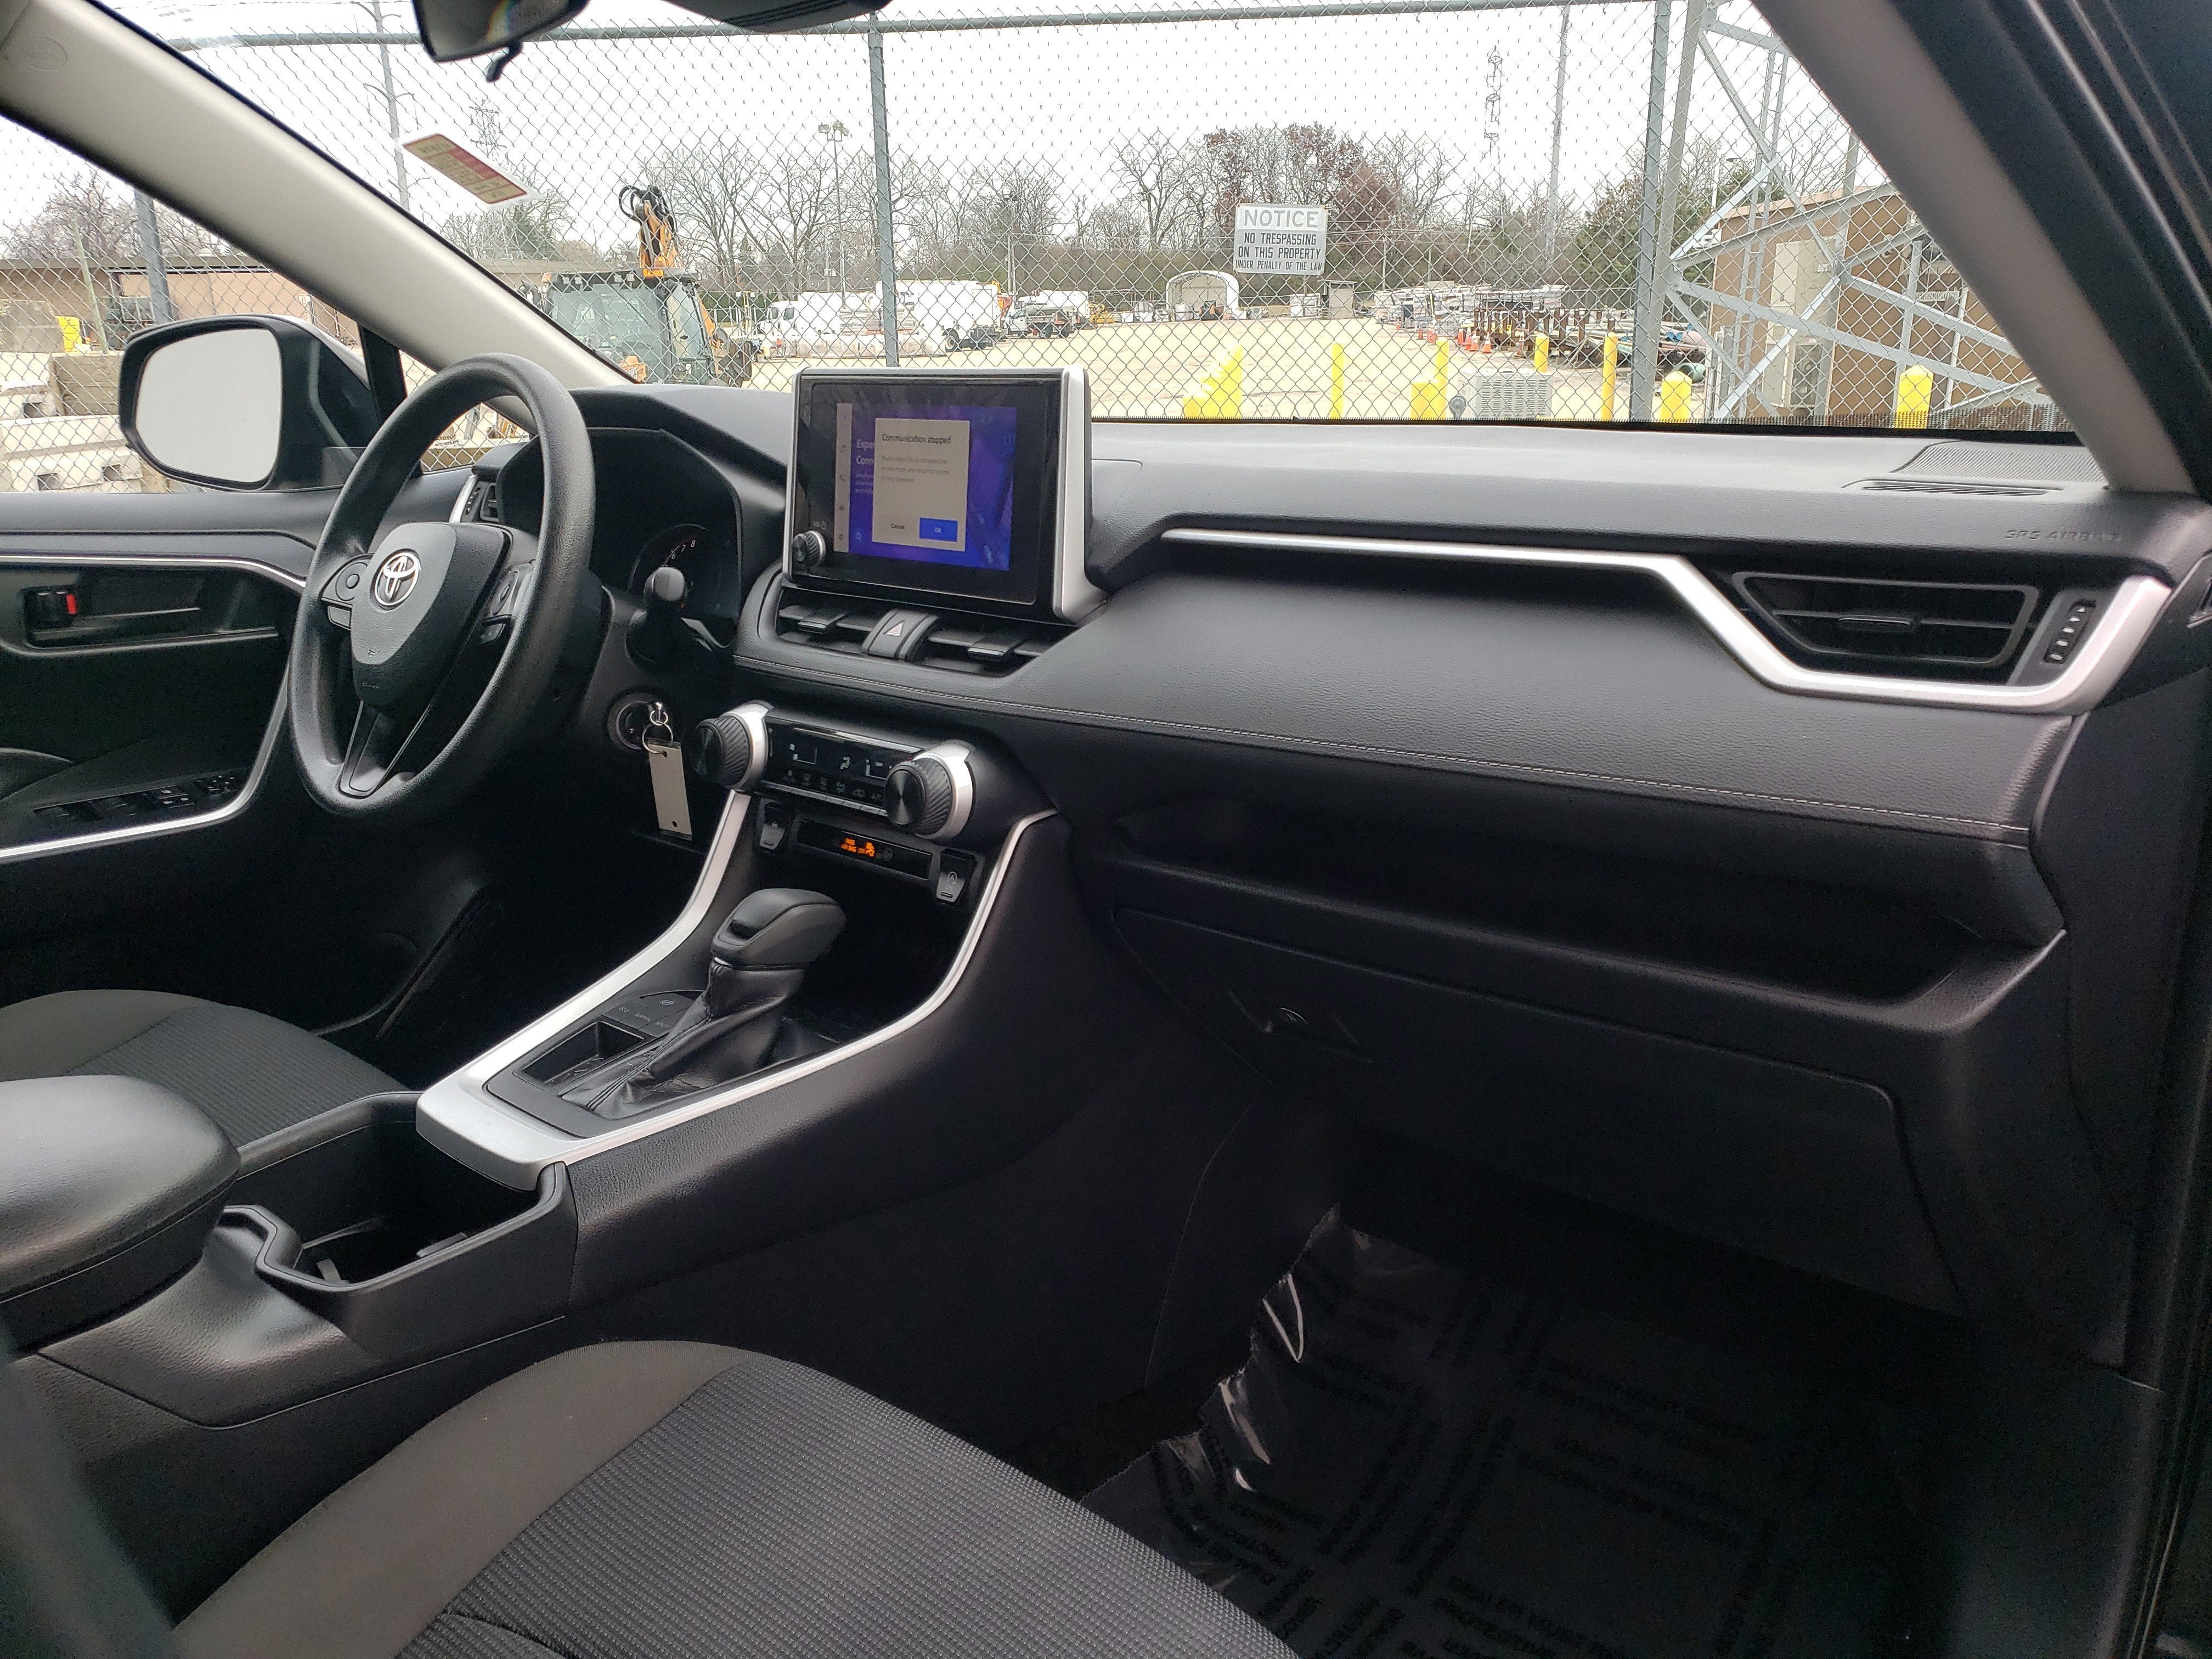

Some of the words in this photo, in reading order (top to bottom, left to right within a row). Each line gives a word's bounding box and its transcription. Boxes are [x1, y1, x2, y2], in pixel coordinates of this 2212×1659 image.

[1244, 209, 1318, 228] NOTICE
[1244, 232, 1255, 244] NO
[1261, 233, 1317, 245] TRESPASSING
[1238, 246, 1249, 257] ON
[1255, 246, 1273, 258] THIS
[1278, 247, 1321, 259] PROPERTY
[1235, 259, 1254, 269] UNDER
[1257, 261, 1282, 270] PENALTY
[1285, 261, 1293, 270] OF
[1296, 262, 1307, 270] THE
[1310, 262, 1323, 271] LAW
[882, 433, 926, 444] Communication
[927, 436, 951, 445] stopped
